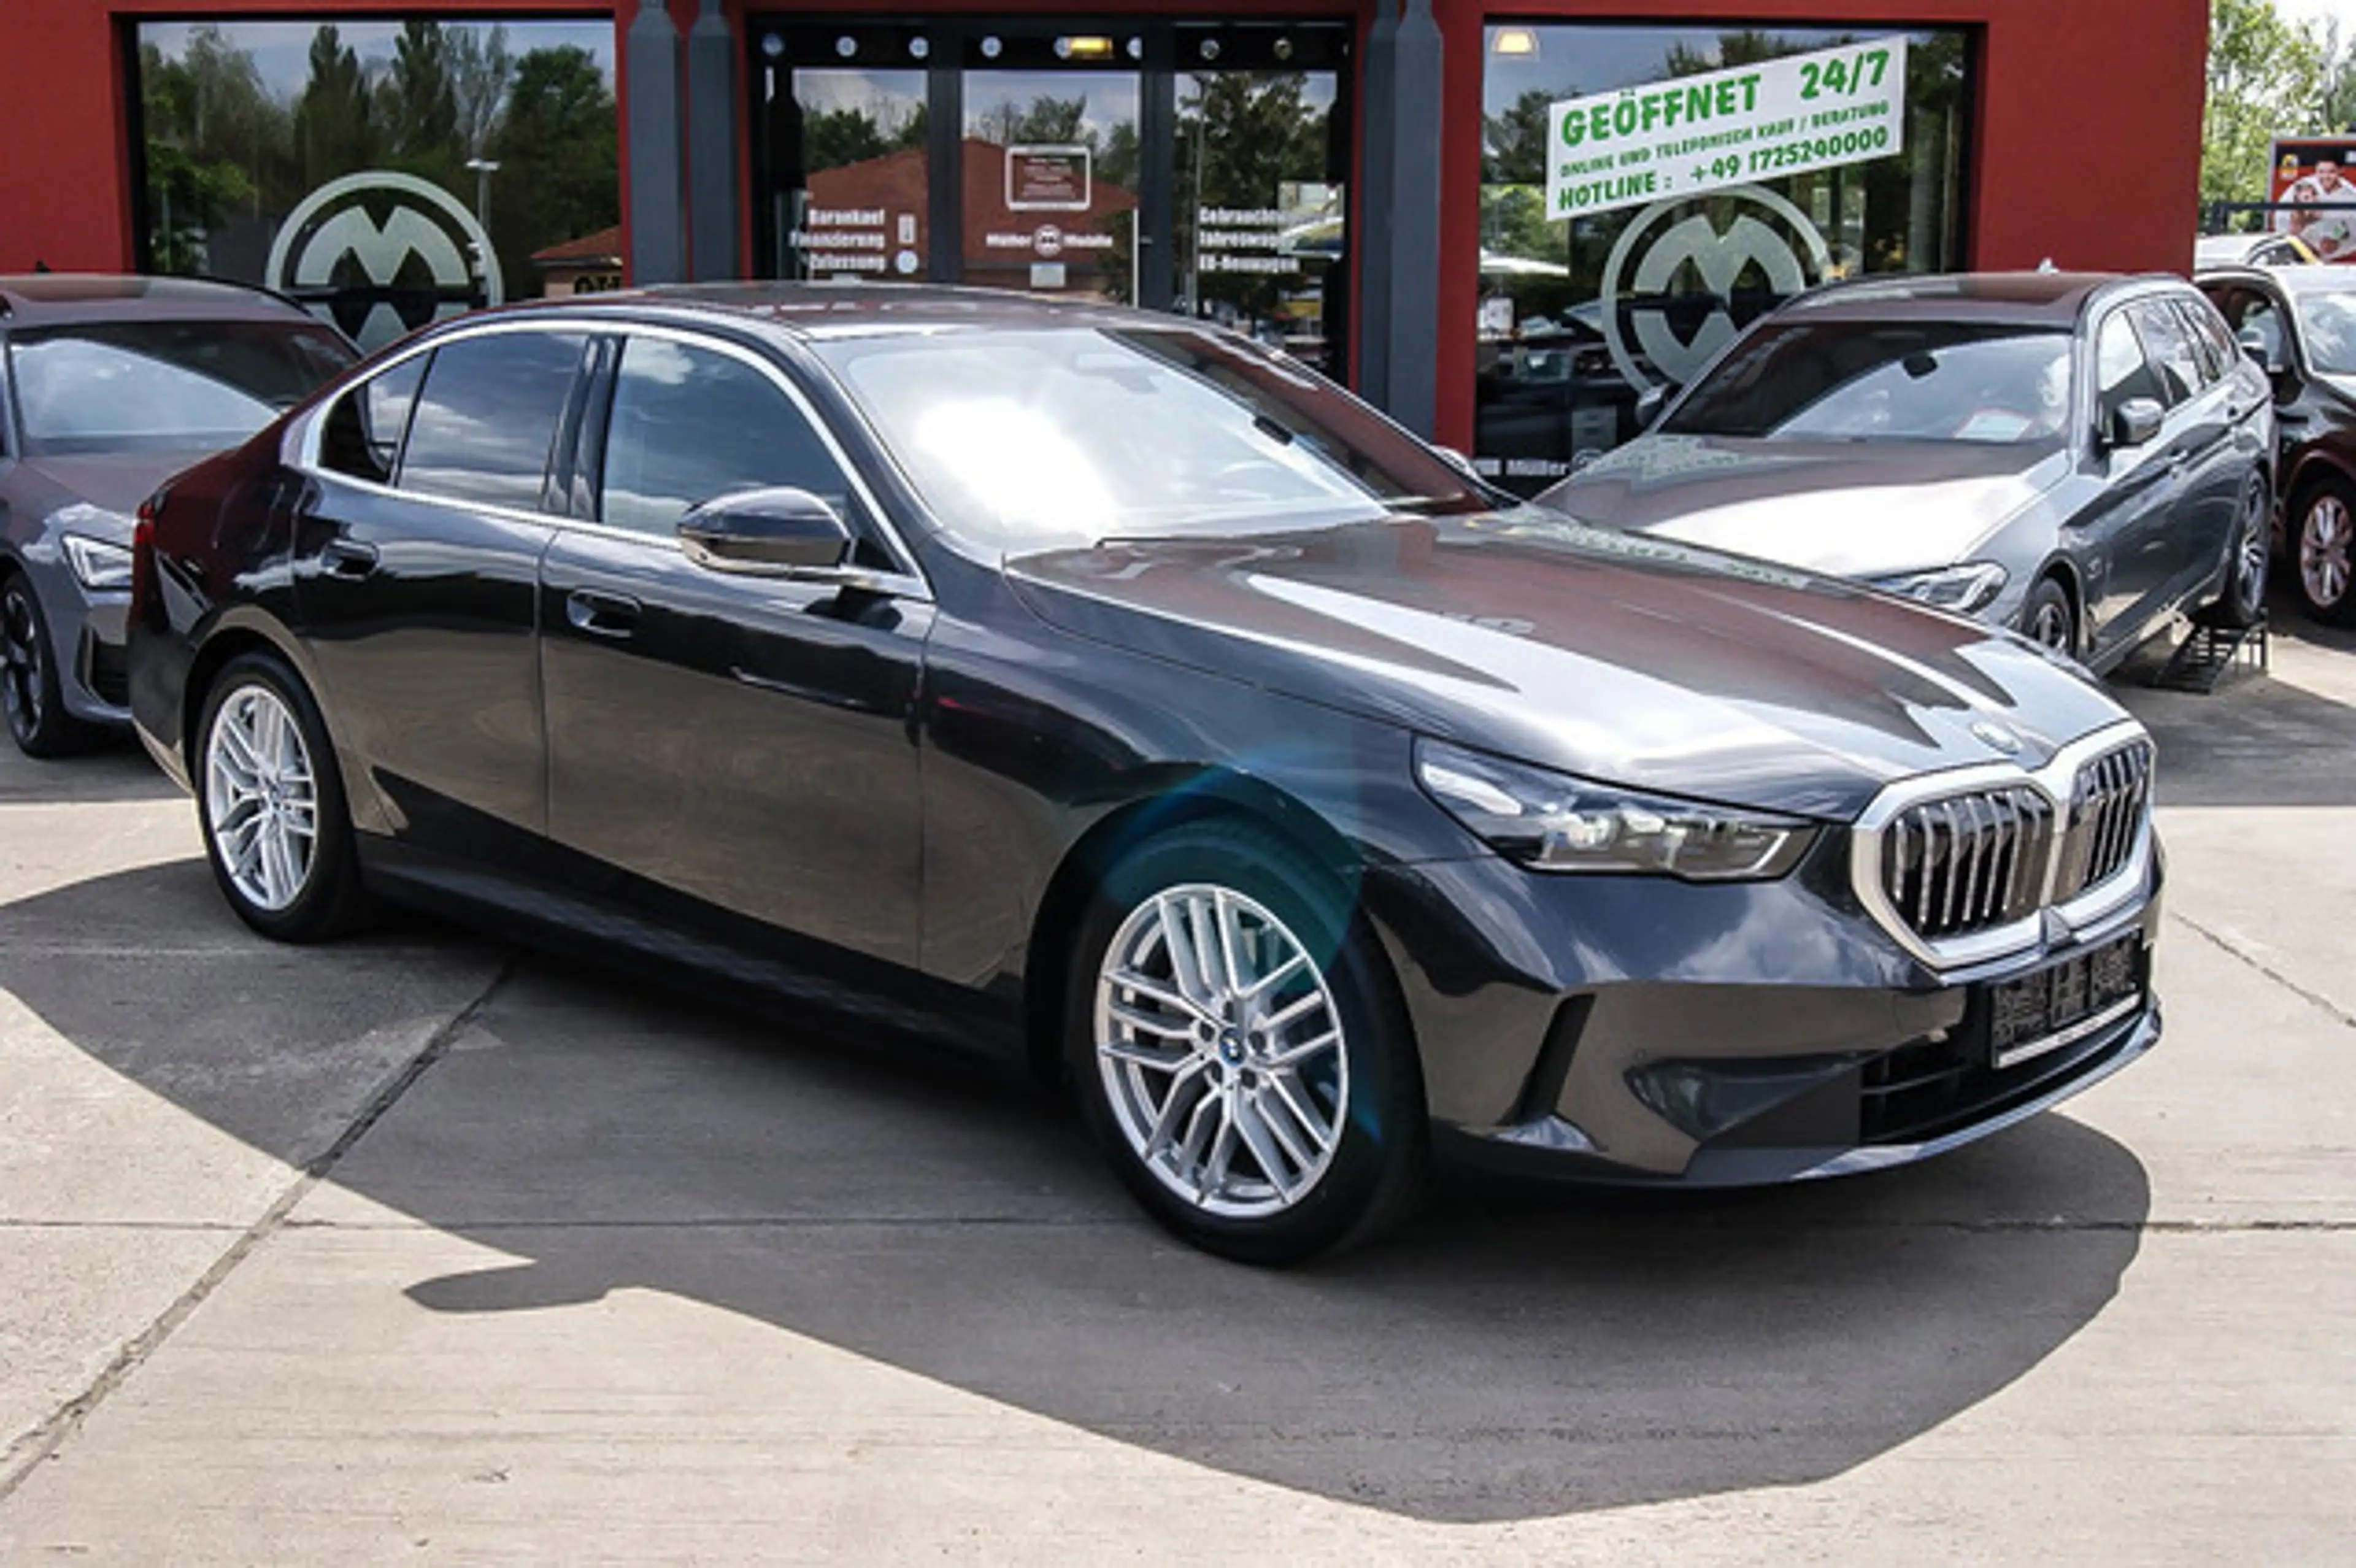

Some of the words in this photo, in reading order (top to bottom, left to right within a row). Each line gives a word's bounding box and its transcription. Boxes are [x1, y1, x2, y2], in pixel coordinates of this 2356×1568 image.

[1559, 155, 1614, 177] ONLINE
[1619, 147, 1651, 166] UND
[1657, 128, 1752, 158] TELEFONISCH
[1812, 99, 1888, 128] BERATUNG
[1561, 73, 1761, 146] GEÖFFNET
[1800, 48, 1890, 100] 24/7
[1558, 171, 1657, 210] HOTLINE
[1690, 153, 1740, 182] +49
[1750, 125, 1888, 172] 1725240000
